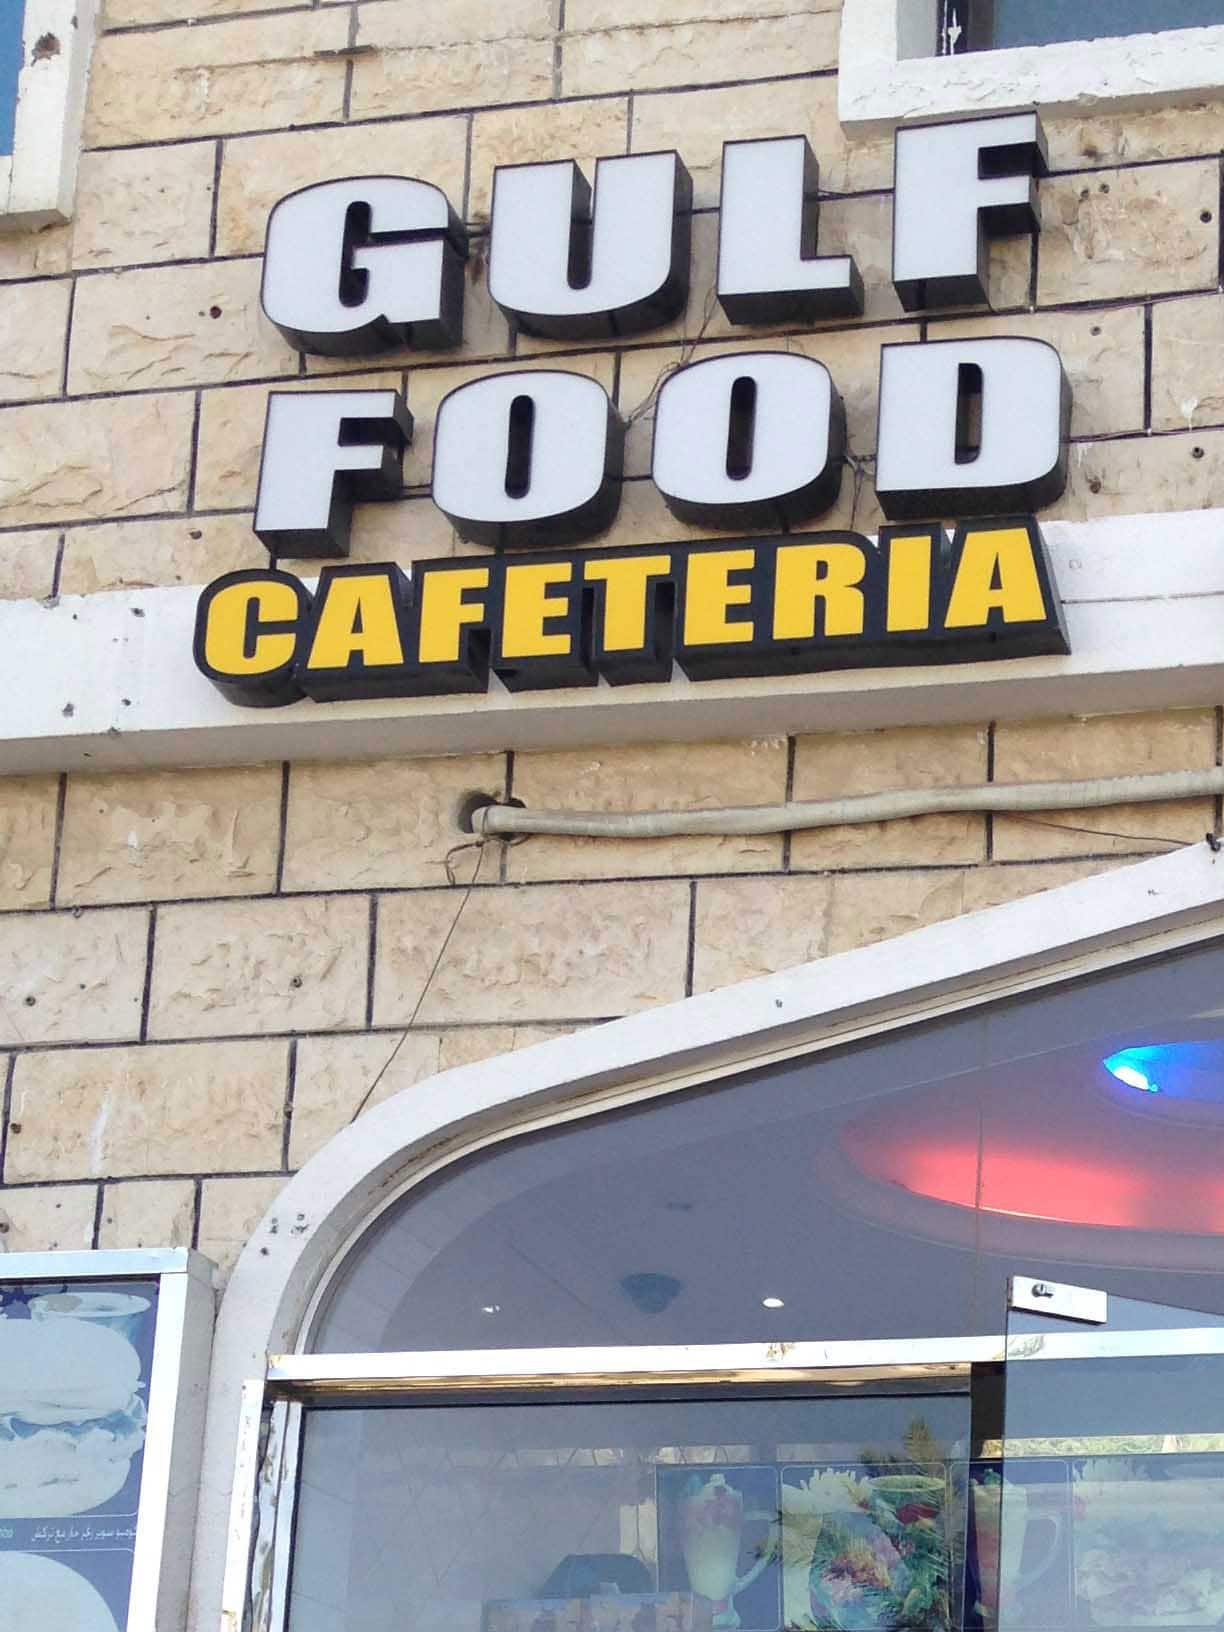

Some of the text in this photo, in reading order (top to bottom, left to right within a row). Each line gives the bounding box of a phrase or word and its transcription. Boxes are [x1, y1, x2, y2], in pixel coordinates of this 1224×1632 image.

[260, 110, 1046, 354] GULF
[254, 336, 1070, 556] FOOD
[198, 520, 1062, 695] CAFETERIA
